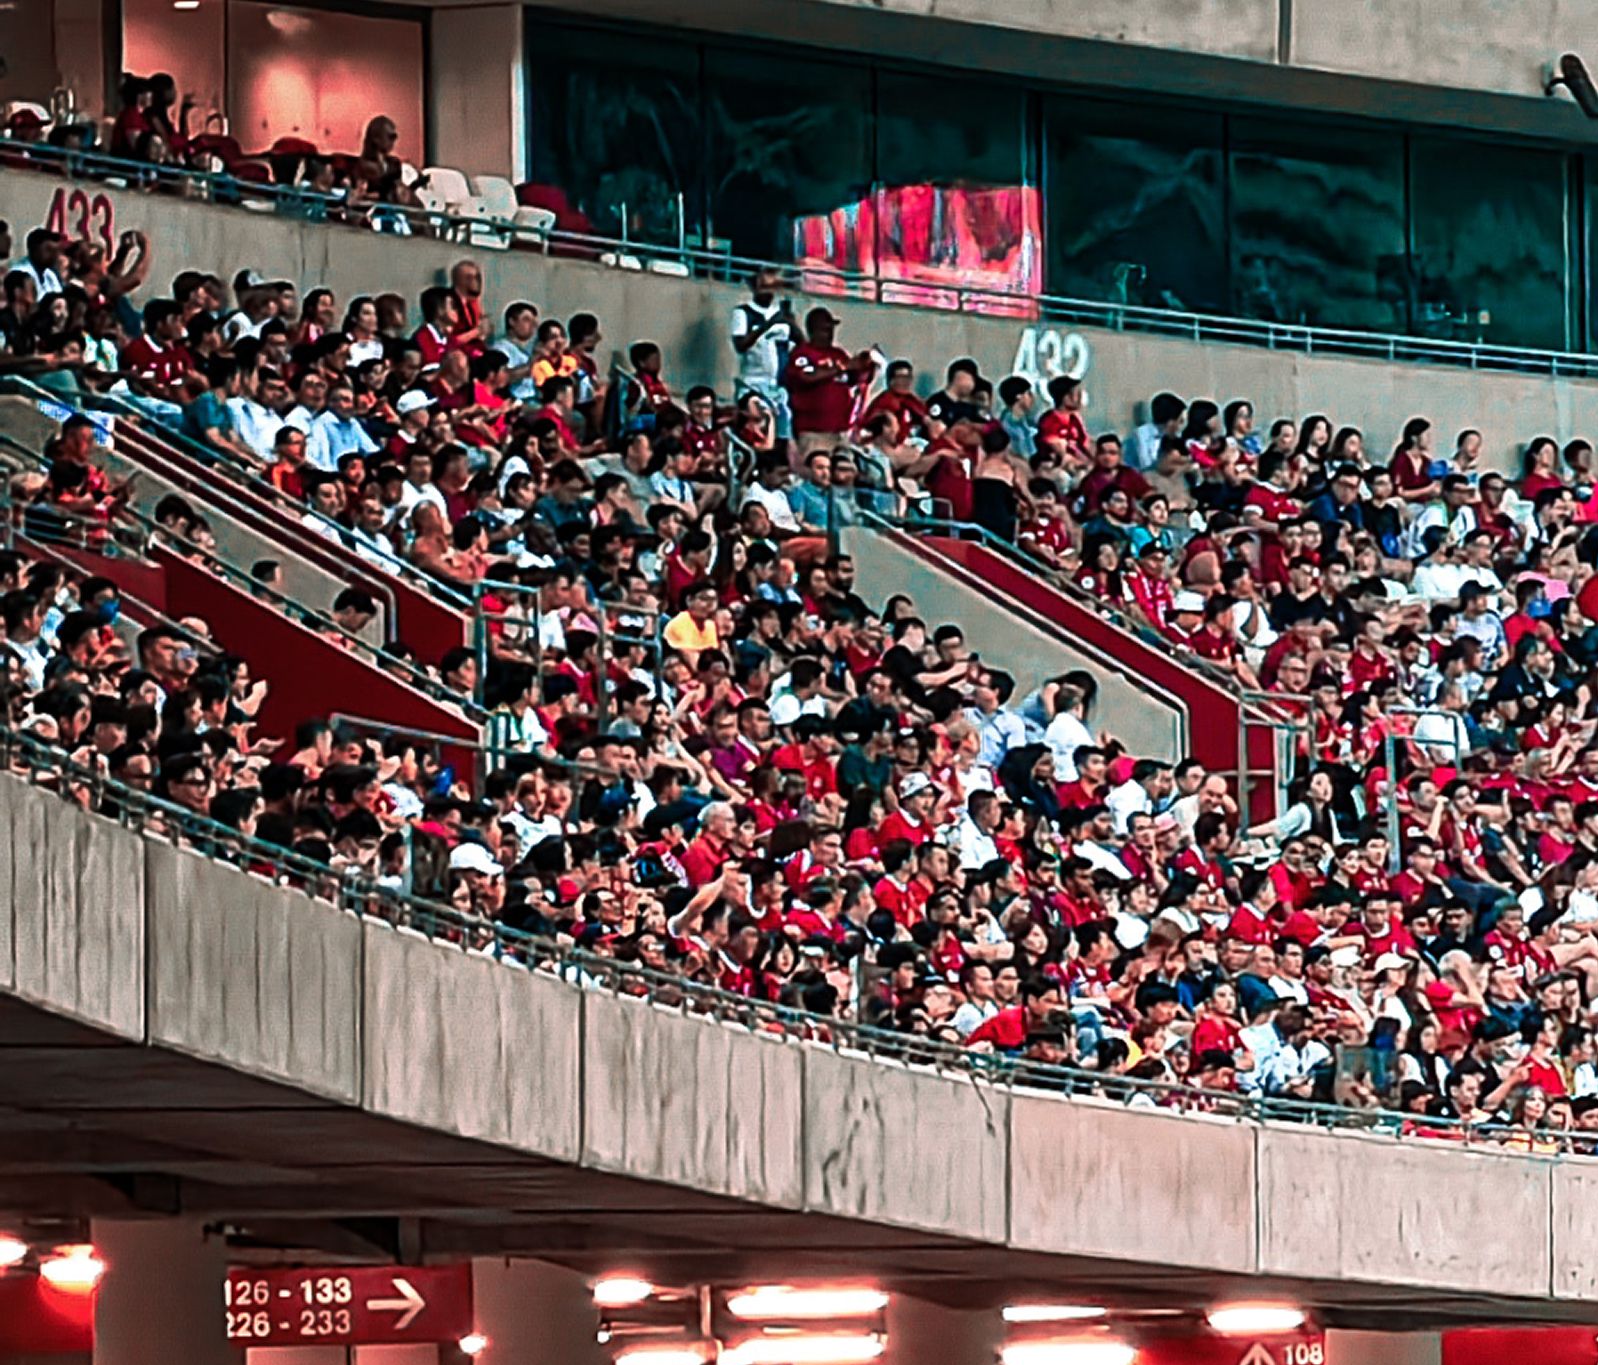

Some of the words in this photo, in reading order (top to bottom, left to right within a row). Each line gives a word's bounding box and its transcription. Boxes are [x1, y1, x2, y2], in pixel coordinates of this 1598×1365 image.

[225, 1279, 270, 1307] 126
[300, 1277, 352, 1305] 133
[225, 1310, 271, 1338] 226
[300, 1309, 351, 1336] 233
